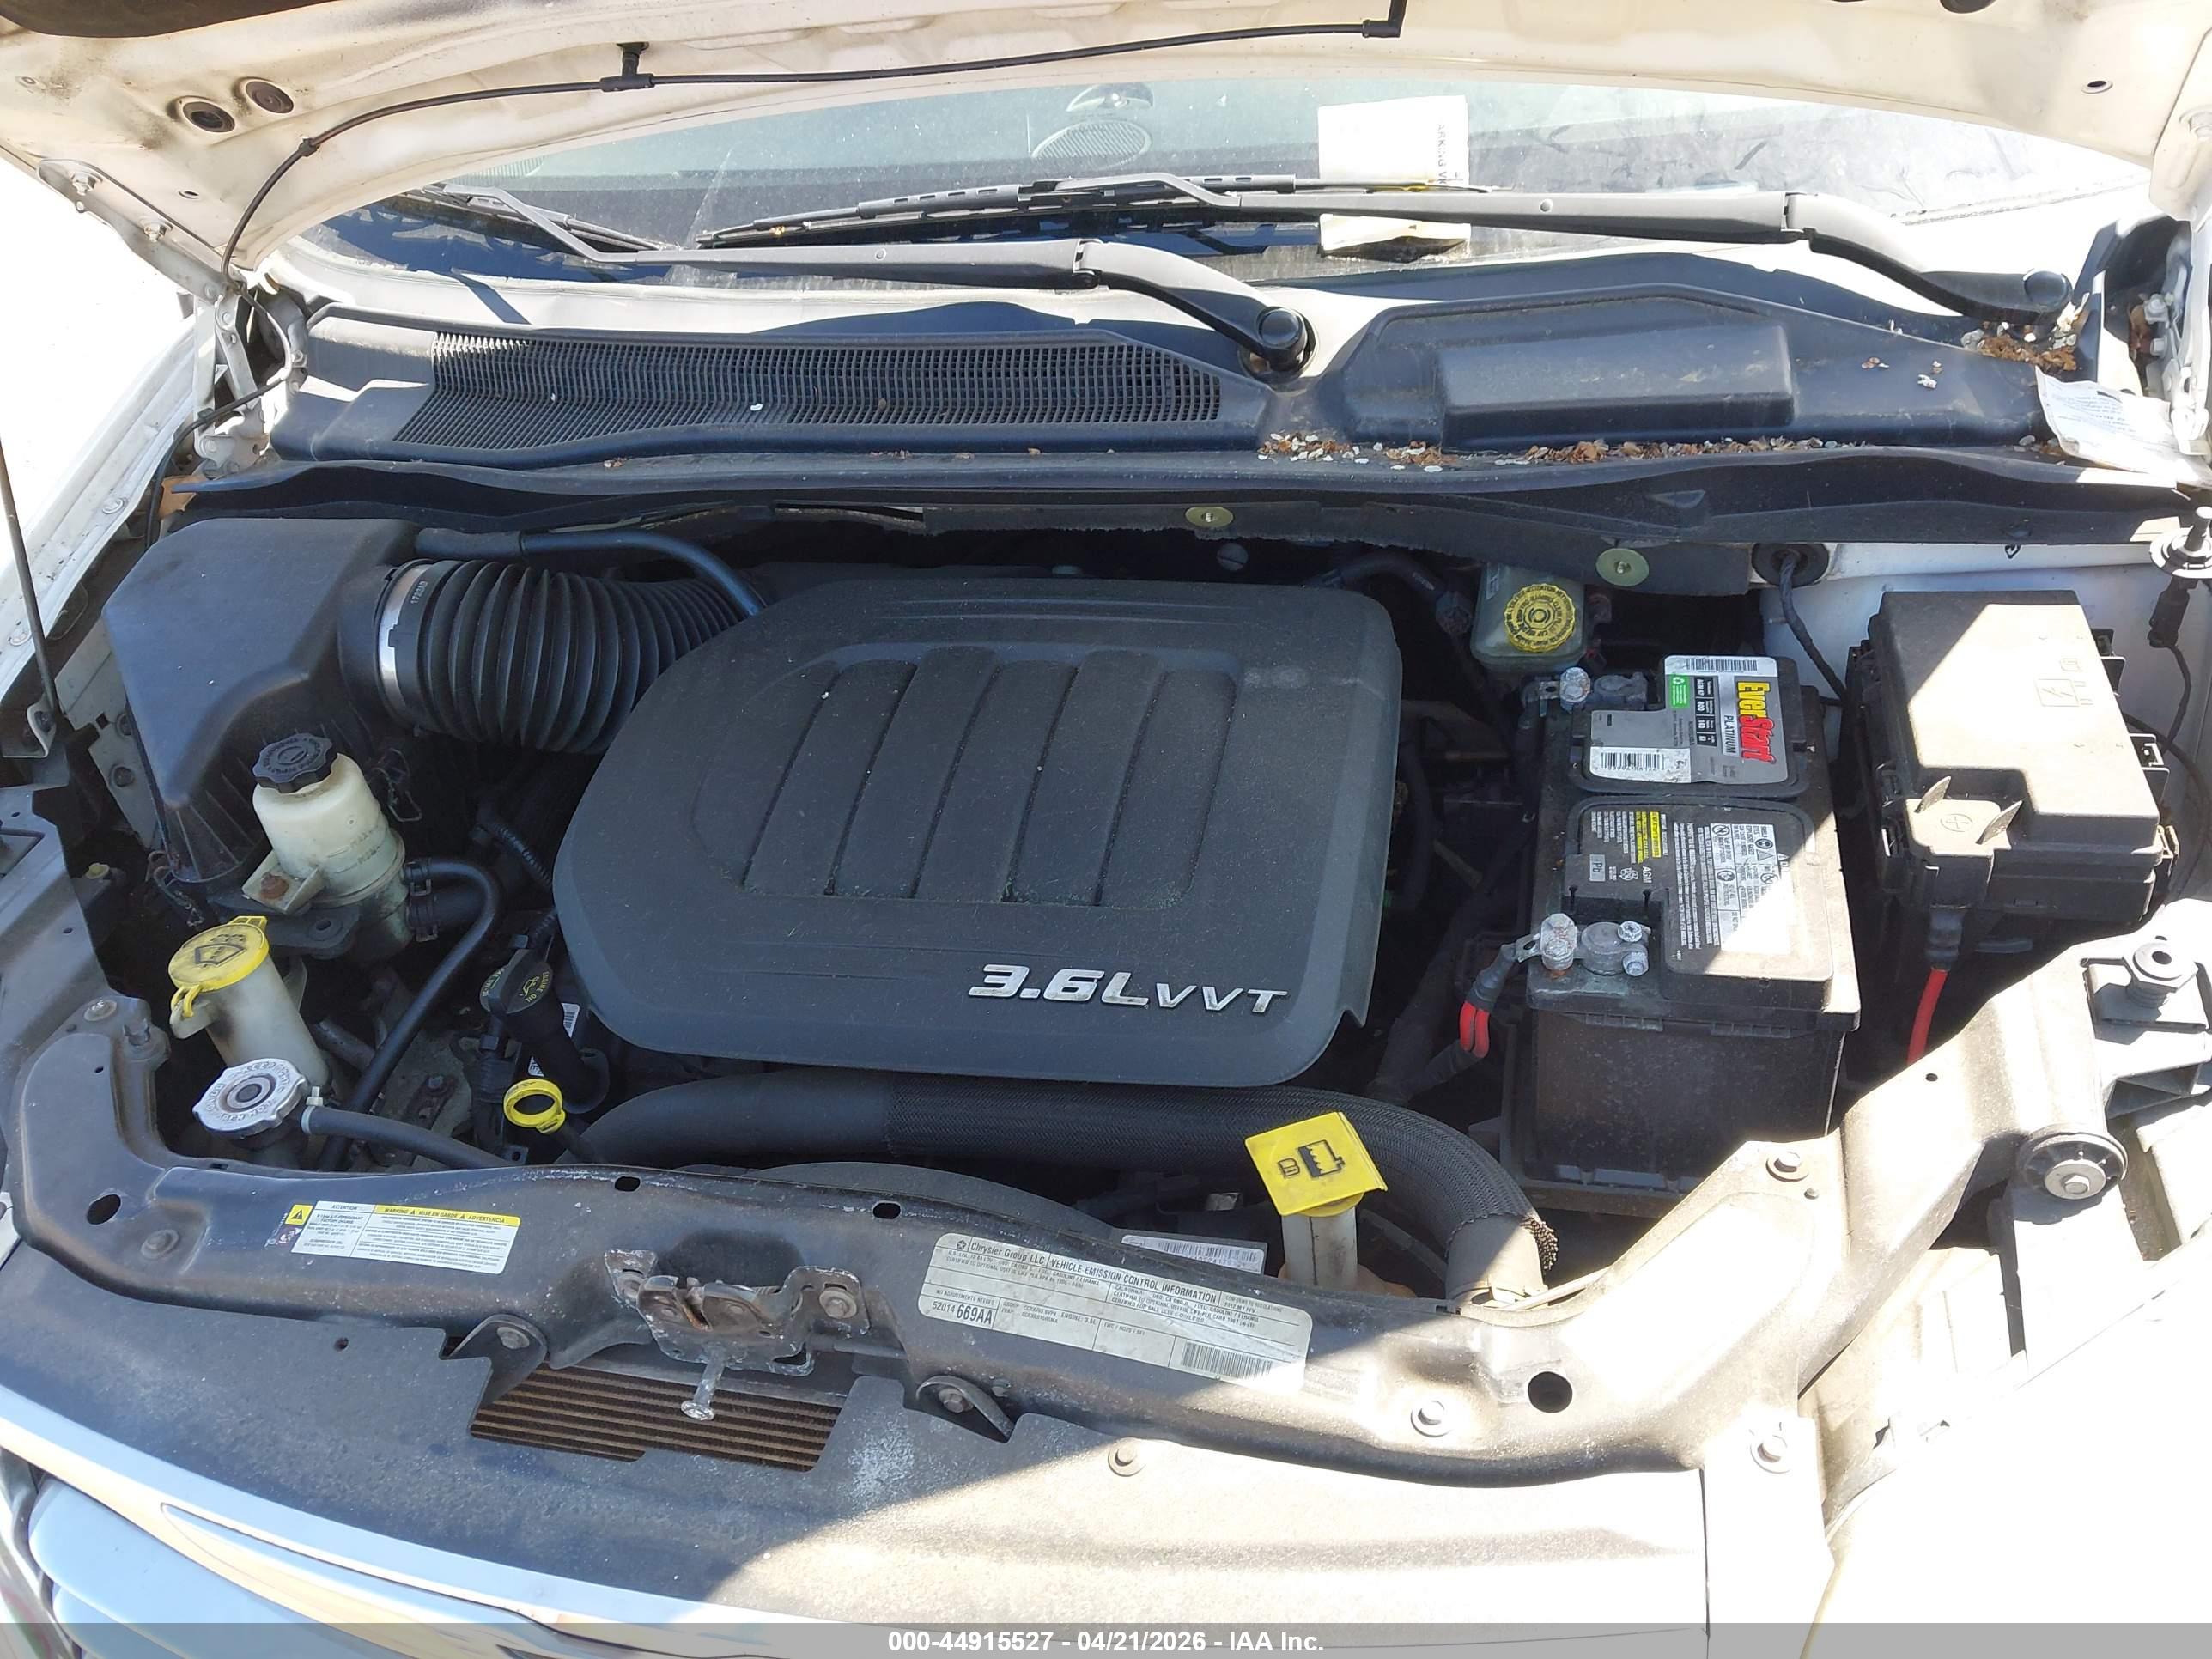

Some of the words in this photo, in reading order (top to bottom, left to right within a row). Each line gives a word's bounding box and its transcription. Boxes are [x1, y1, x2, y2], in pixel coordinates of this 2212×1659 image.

[1723, 714, 1737, 754] PLATINUM
[1737, 681, 1777, 764] EverStart
[1592, 862, 1603, 873] Pb
[1642, 866, 1653, 884] AGM
[525, 994, 537, 1004] OIL
[968, 963, 1150, 1007] 3.6L
[1155, 981, 1290, 1014] VVT
[468, 1215, 505, 1224] ADVERTENCIA
[970, 1242, 1003, 1256] Chrysler
[1004, 1249, 1027, 1261] Group
[1029, 1254, 1045, 1265] LLC
[1051, 1258, 1082, 1273] VEHICLE
[1084, 1266, 1121, 1281] EMISSION
[1123, 1274, 1159, 1290] CONTROL
[1161, 1283, 1217, 1304] INFORMATION
[932, 1300, 956, 1313] 52014
[956, 1304, 993, 1325] 669AA
